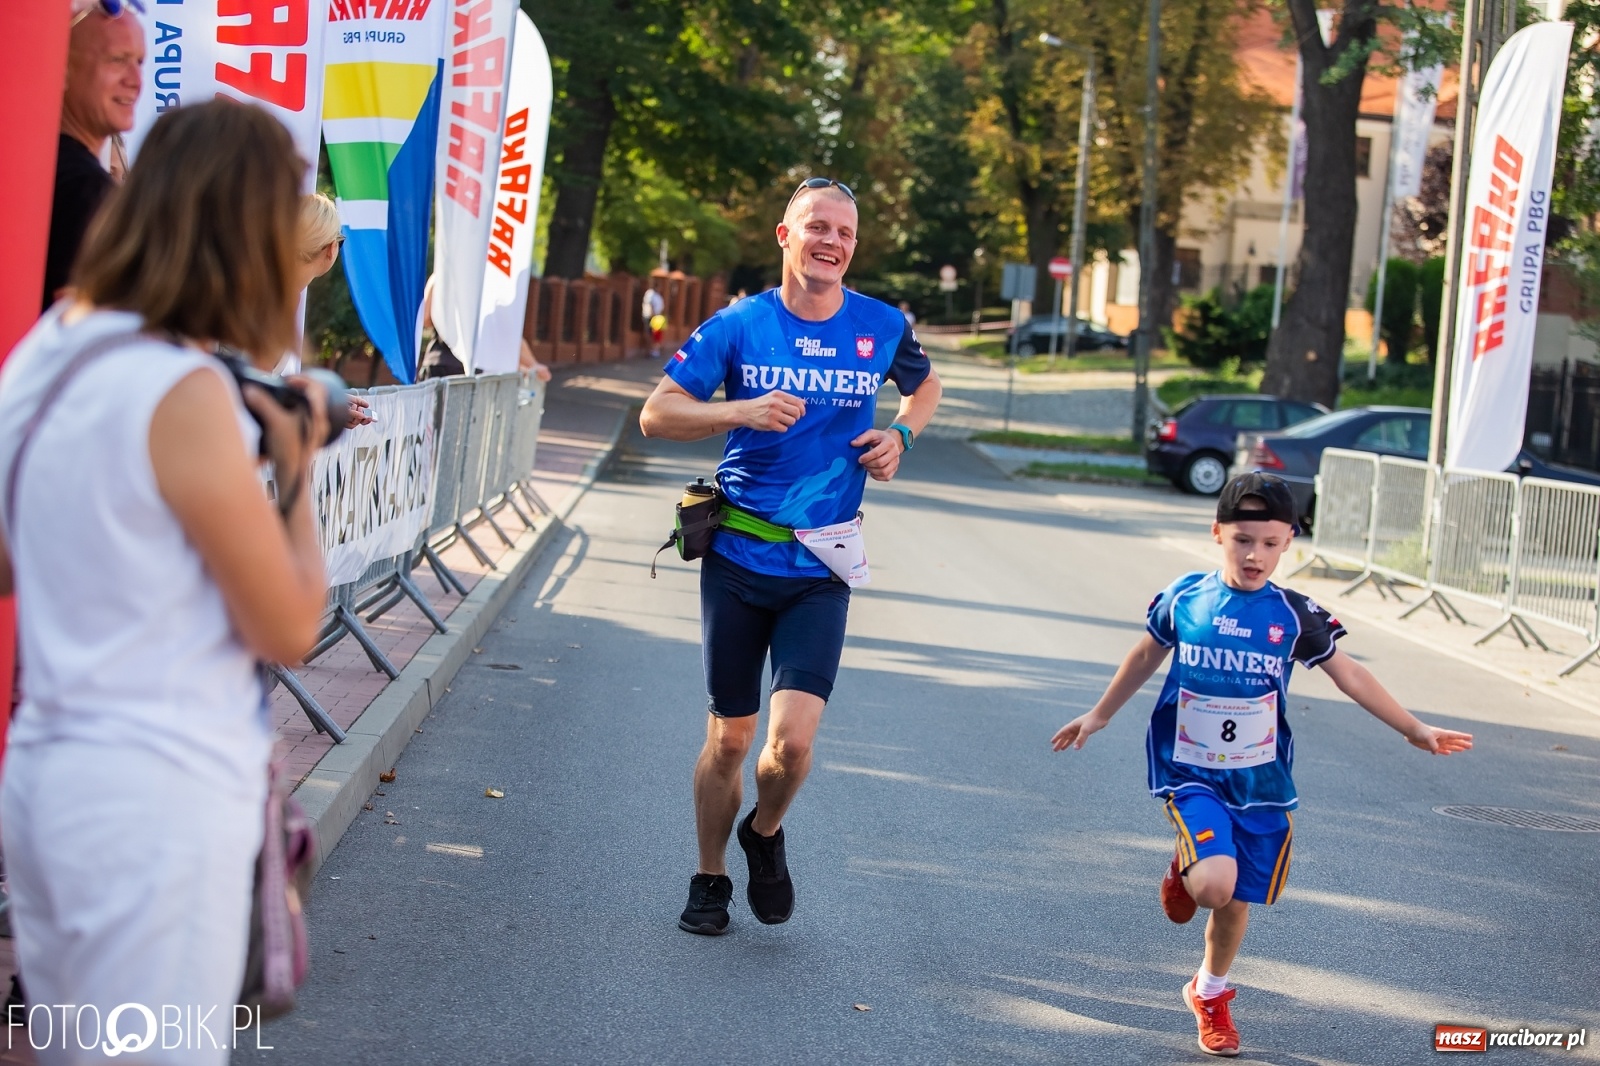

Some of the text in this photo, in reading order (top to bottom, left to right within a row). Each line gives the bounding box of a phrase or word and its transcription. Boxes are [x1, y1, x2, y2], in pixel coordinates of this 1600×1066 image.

[1466, 134, 1524, 363] RAFAKO
[1519, 190, 1546, 314] GRUPA PBG
[741, 364, 881, 396] RUNNERS
[831, 398, 862, 408] TEAM
[1178, 640, 1283, 678] RUNNERS
[1221, 719, 1237, 743] 8
